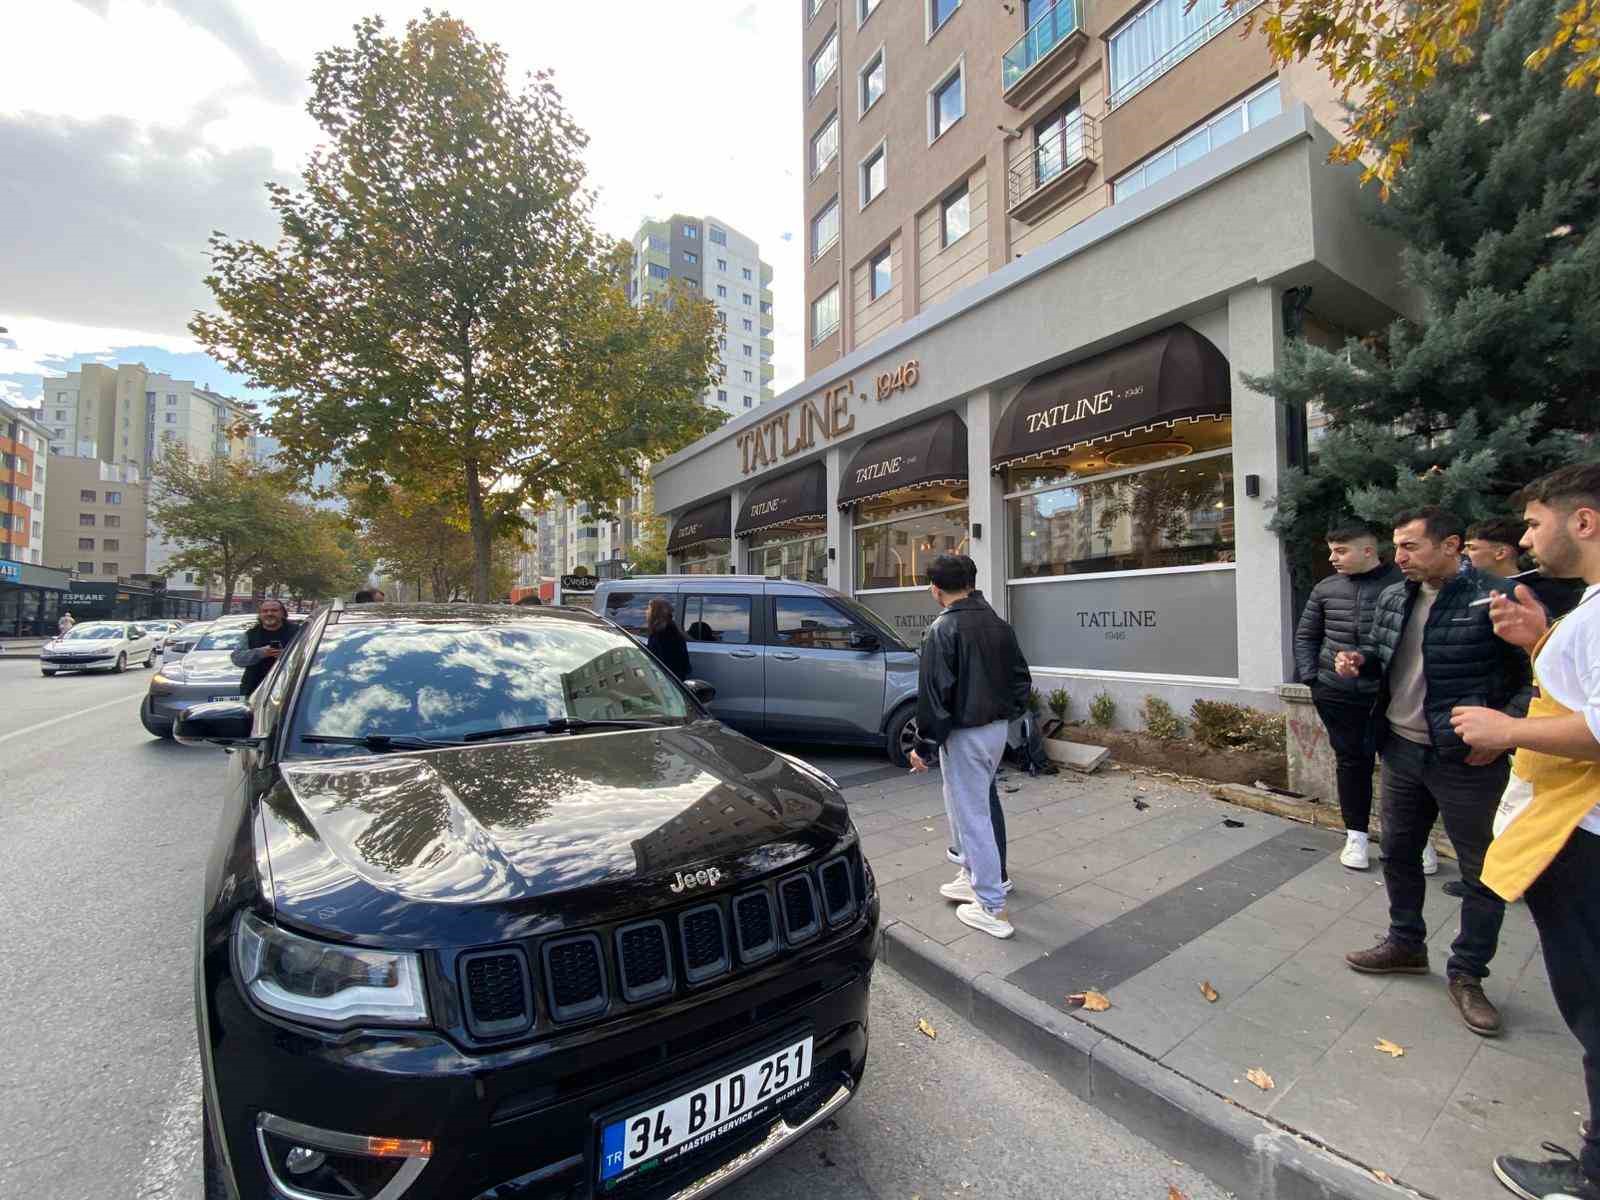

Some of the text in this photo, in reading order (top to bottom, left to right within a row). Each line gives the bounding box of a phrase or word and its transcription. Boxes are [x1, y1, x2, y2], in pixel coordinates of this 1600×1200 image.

[736, 360, 919, 474] TATLINE 1946
[1026, 390, 1113, 433] TATLINE
[856, 456, 902, 483] TATLINE
[1076, 610, 1157, 628] TATLINE
[670, 867, 721, 893] Jeep
[629, 1109, 672, 1160] 34
[688, 1073, 746, 1134] BID
[757, 1045, 805, 1101] 251
[679, 1130, 717, 1154] MASTER
[716, 1110, 754, 1137] SERVICE
[606, 1150, 623, 1167] TR
